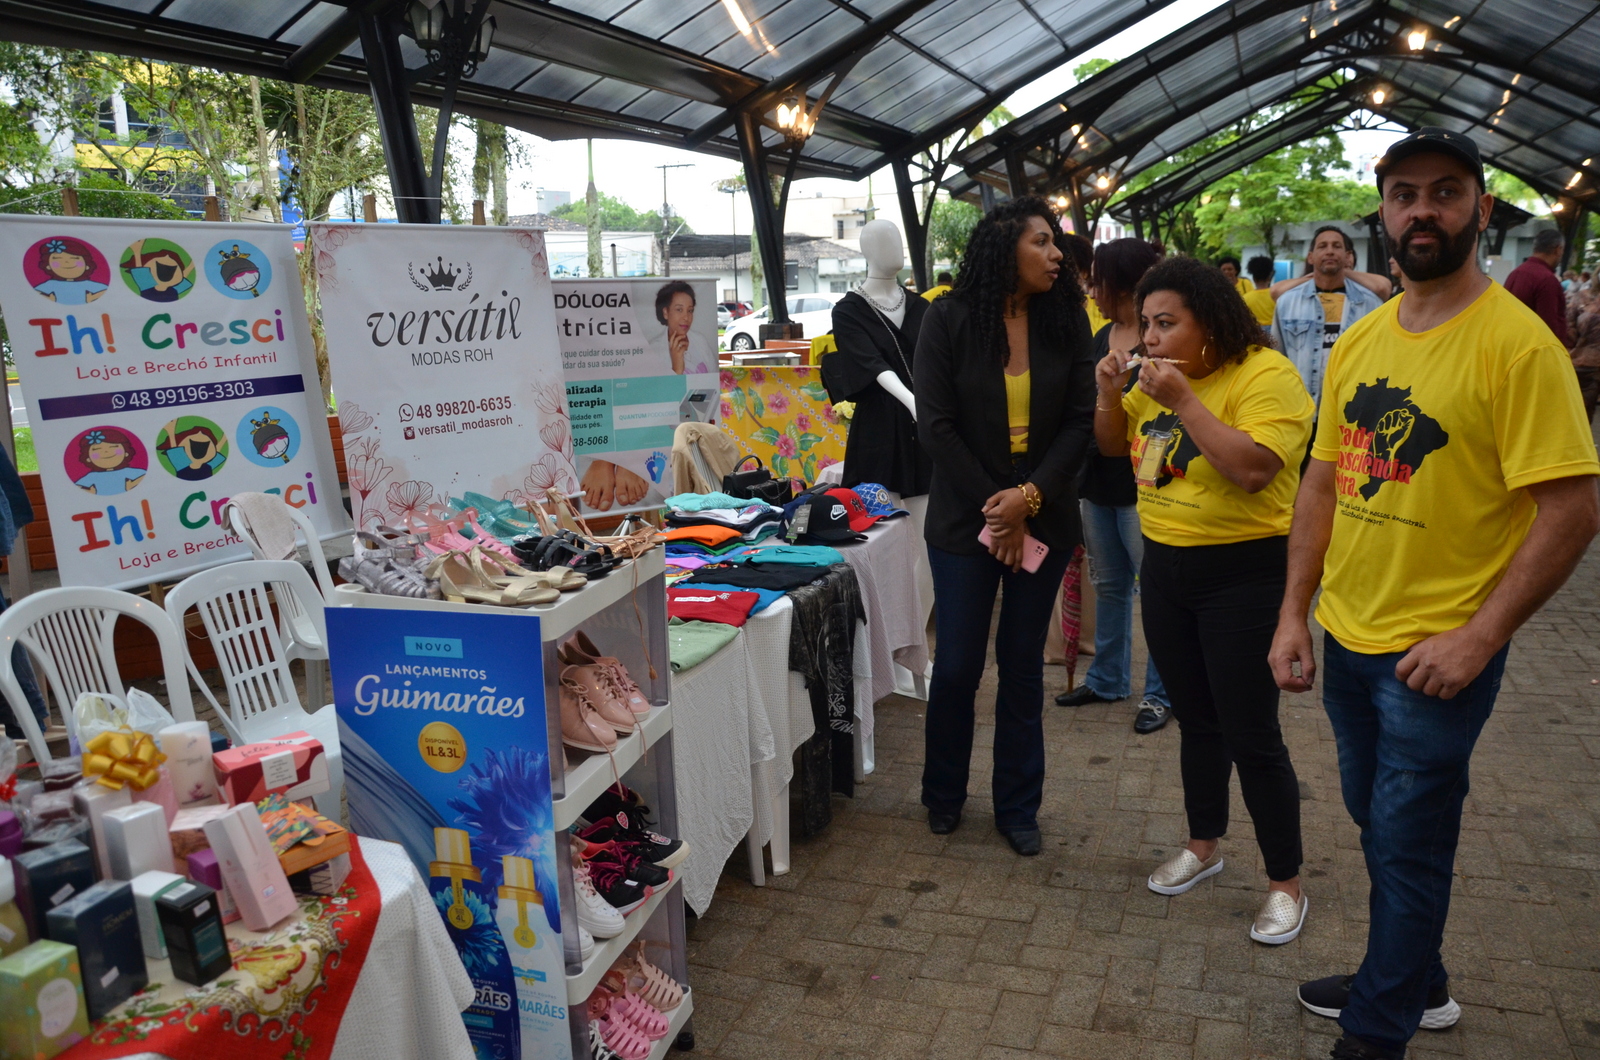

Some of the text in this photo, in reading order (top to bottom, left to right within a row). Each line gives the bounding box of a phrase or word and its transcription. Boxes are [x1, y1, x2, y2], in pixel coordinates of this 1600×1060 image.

[554, 290, 631, 309] DÓLOGA
[366, 290, 522, 347] versátil
[556, 317, 632, 337] trícia
[28, 309, 285, 358] Ih! Cresci
[411, 347, 494, 367] MODAS ROH
[563, 351, 578, 360] que
[578, 349, 600, 358] cuidar
[601, 348, 614, 357] dos
[632, 347, 644, 358] pés
[76, 352, 278, 381] Loja e Brechó Infantil
[577, 360, 587, 369] da
[587, 360, 600, 369] sua
[601, 358, 626, 368] saúde?
[128, 381, 255, 408] 48 99196-3303
[565, 384, 603, 396] alizada
[416, 395, 512, 421] 48 99820-6635
[568, 397, 607, 409] terapia
[592, 412, 604, 420] em
[618, 411, 647, 421] QUANTUM
[418, 415, 513, 437] versatil_modasroh
[571, 422, 587, 430] seus
[572, 435, 609, 448] 38-5068
[71, 472, 318, 553] Ih! Crci
[118, 552, 162, 570] Loja
[167, 546, 179, 559] e
[415, 641, 453, 653] NOVO
[385, 663, 487, 681] LANÇAMENTOS
[354, 674, 526, 718] Guimarães
[425, 745, 462, 760] 1L&3L
[463, 1005, 496, 1017] NTRADO
[517, 998, 566, 1020] MARÃES
